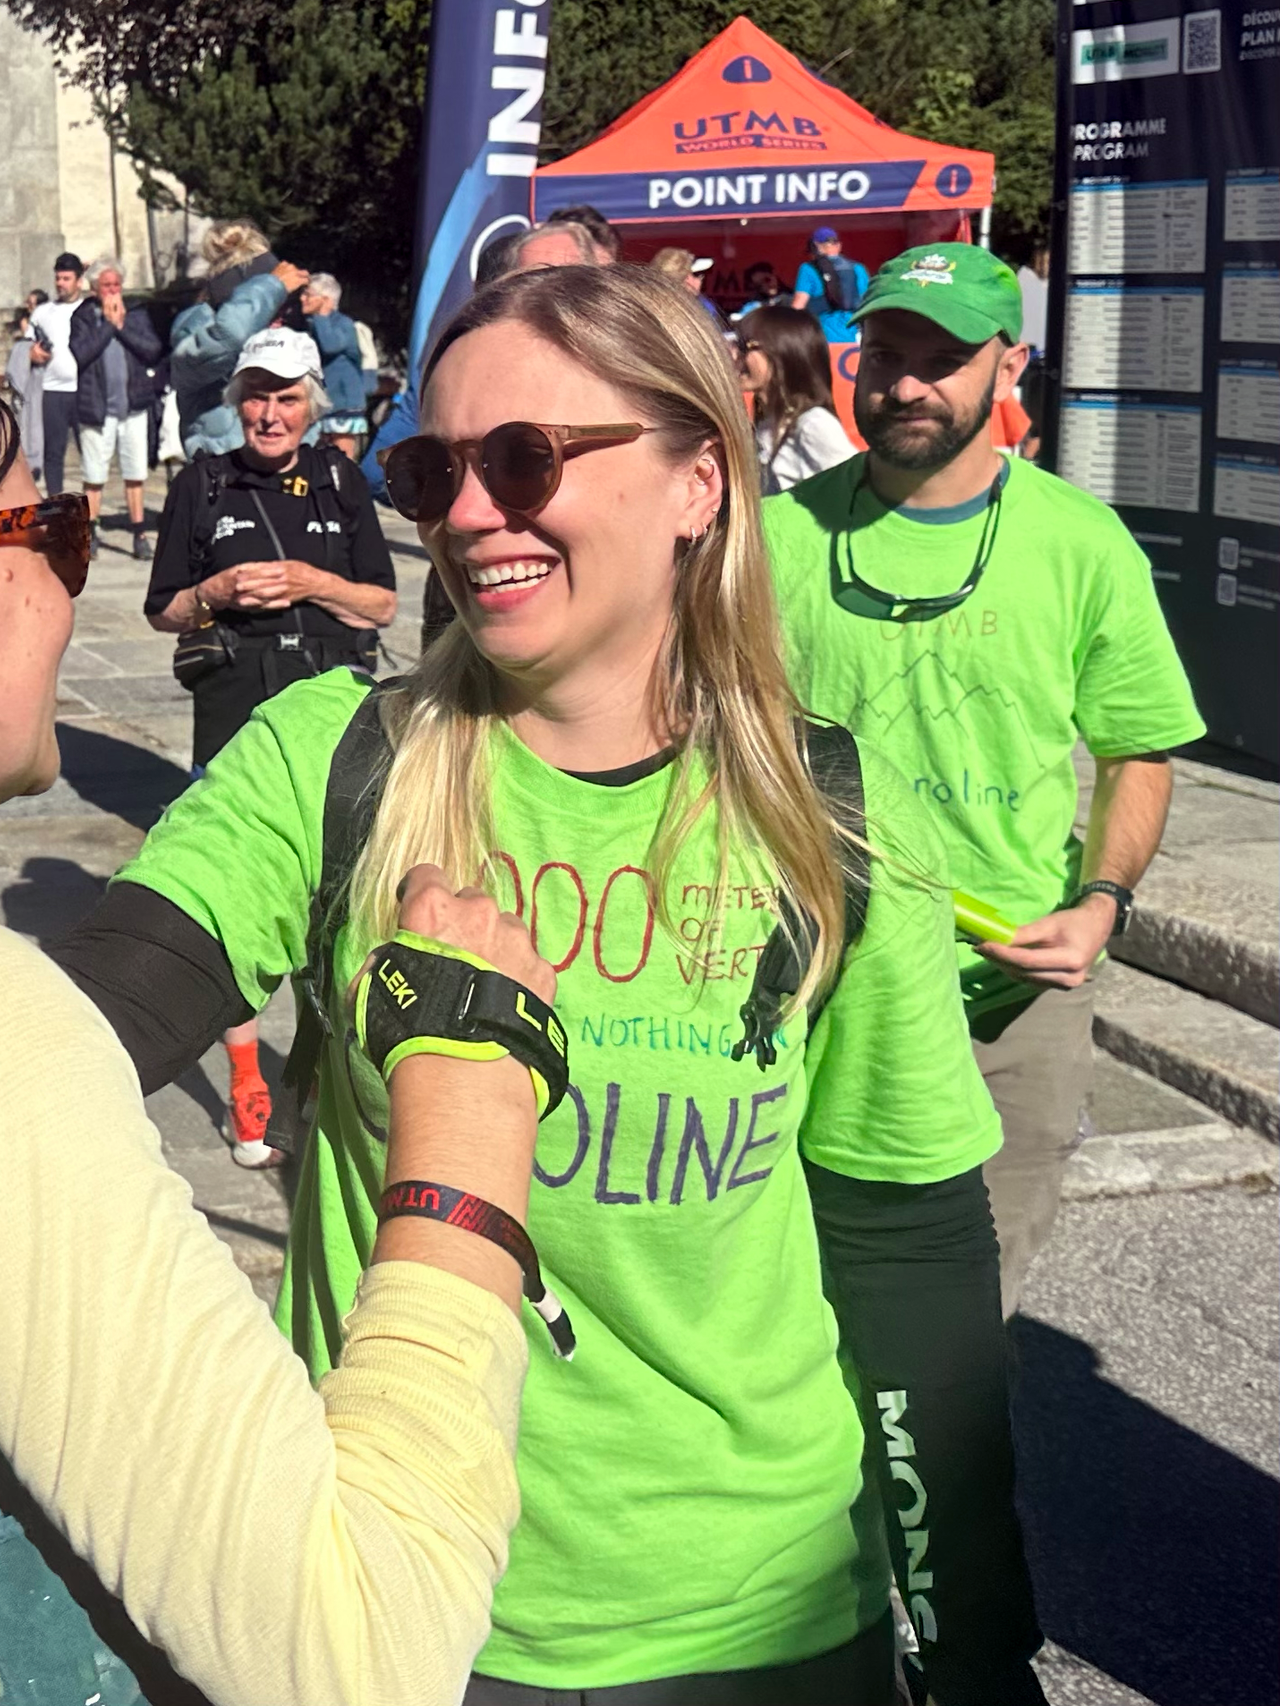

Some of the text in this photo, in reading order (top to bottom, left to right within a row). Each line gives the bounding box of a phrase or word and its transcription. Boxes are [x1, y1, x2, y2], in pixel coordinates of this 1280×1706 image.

[486, 0, 549, 177] INF
[674, 110, 822, 139] UTMB
[681, 137, 822, 153] WORLD SERIES
[1073, 142, 1149, 161] PROGRAM
[649, 170, 870, 209] POINT INFO
[378, 959, 418, 1010] LEKI
[581, 1013, 733, 1058] NOTHING
